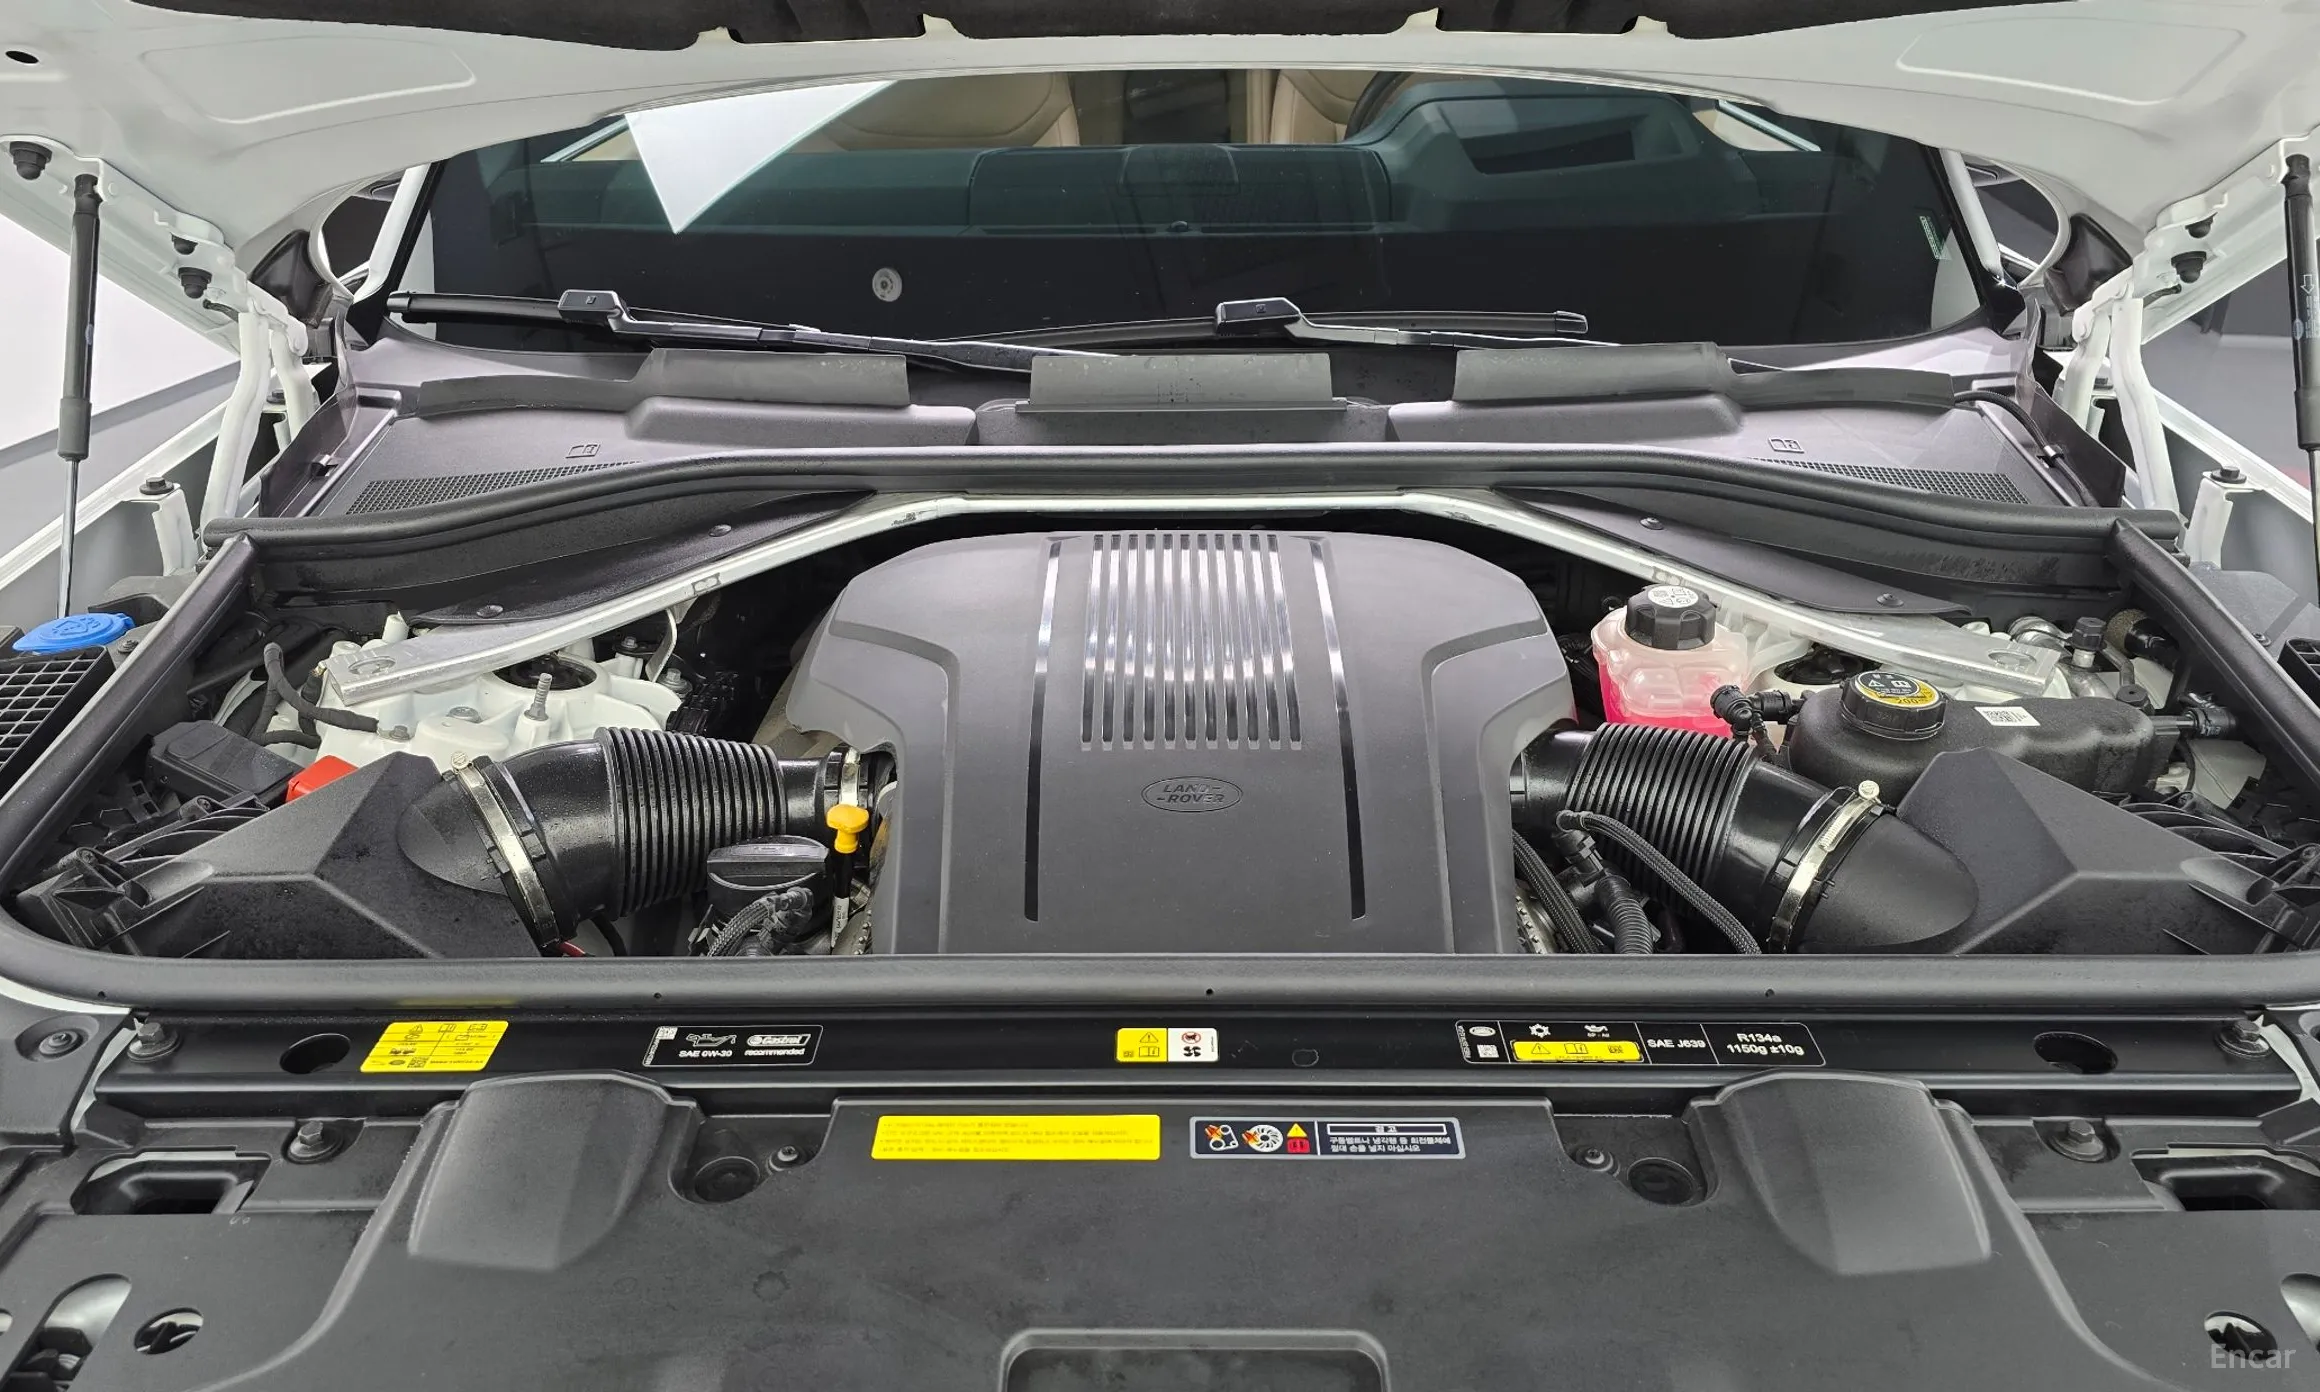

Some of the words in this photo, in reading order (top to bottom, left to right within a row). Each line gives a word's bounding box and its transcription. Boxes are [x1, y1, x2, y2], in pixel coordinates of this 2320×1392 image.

[1736, 1033, 1782, 1043] R134a
[1647, 1039, 1674, 1048] SAE
[1677, 1039, 1706, 1048] J639
[679, 1050, 700, 1058] SAE
[701, 1050, 733, 1058] 0W-30
[744, 1048, 805, 1056] recommended
[1726, 1044, 1768, 1055] 1150g
[1769, 1044, 1804, 1056] ±10g
